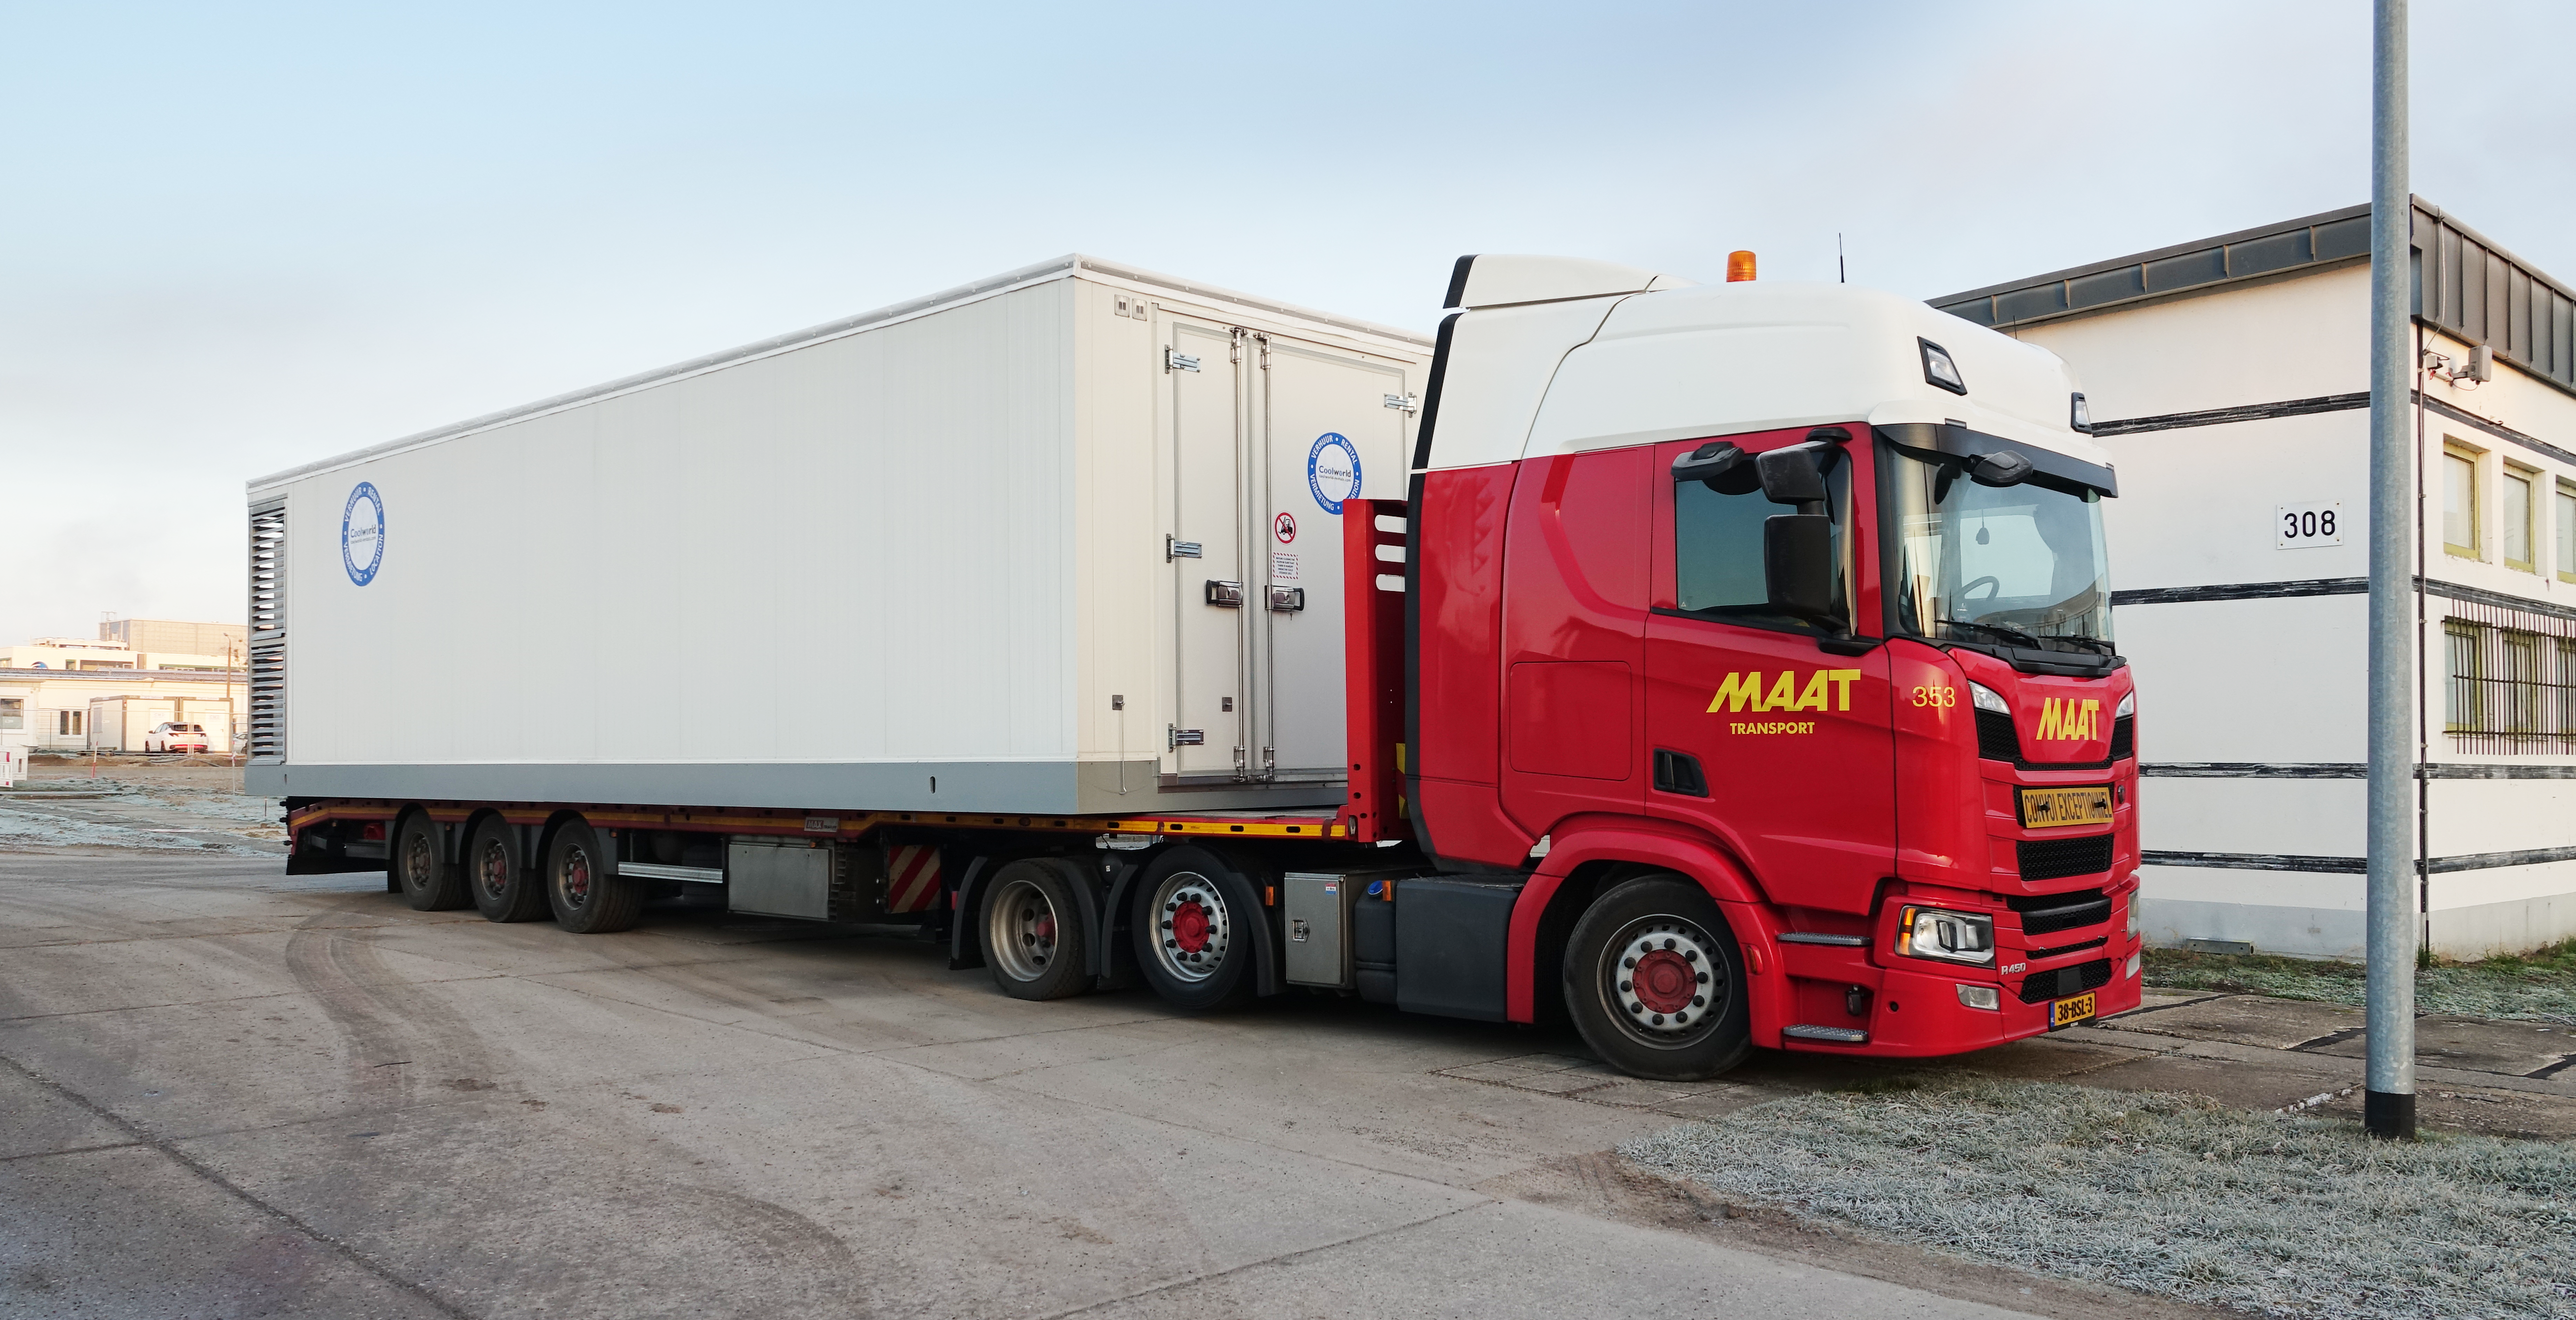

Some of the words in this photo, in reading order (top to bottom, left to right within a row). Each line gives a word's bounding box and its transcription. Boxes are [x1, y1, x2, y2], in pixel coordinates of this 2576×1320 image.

[1311, 434, 1334, 459] VERHUUR
[1340, 438, 1358, 465] RENTAL
[1318, 465, 1352, 478] Coolworld
[367, 486, 382, 516] RENTAL
[1309, 473, 1335, 511] VERMIETUNG
[2284, 510, 2336, 539] 308
[1707, 669, 1861, 713] MAAT
[1912, 686, 1956, 708] 353
[1729, 721, 1816, 735] TRANSPORT
[2036, 697, 2100, 741] MAAT
[807, 820, 822, 829] MAX
[2057, 996, 2093, 1022] 38-BSL-3
